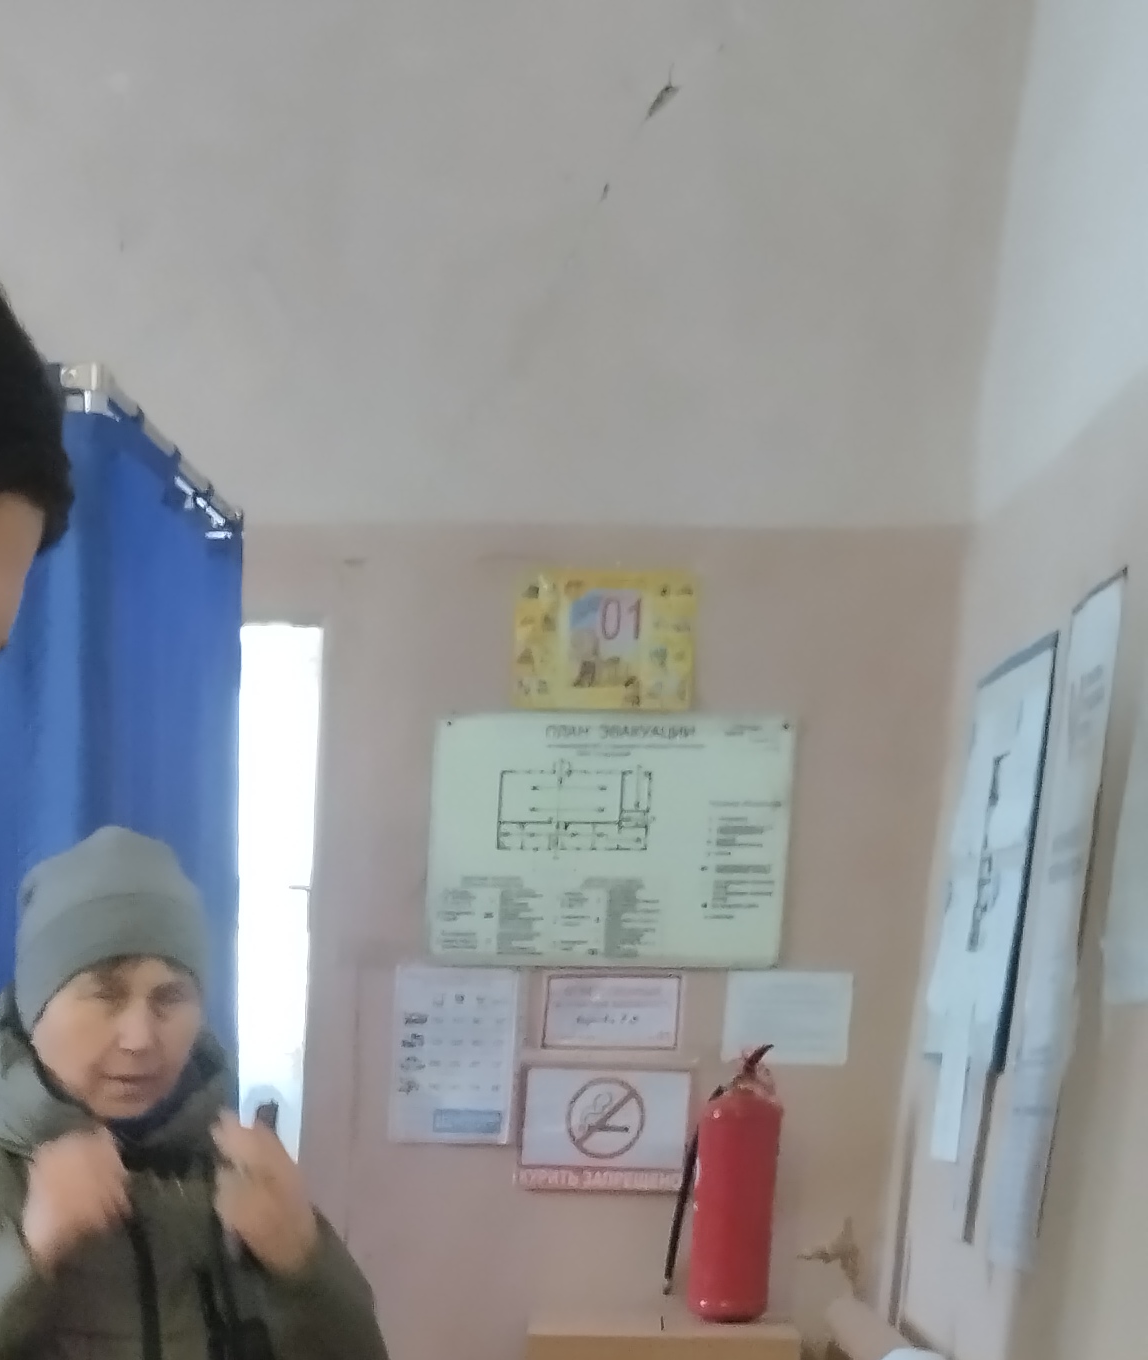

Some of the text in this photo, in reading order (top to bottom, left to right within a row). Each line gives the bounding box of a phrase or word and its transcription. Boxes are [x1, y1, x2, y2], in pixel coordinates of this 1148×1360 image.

[601, 598, 642, 640] 01
[545, 723, 592, 739] ПЛАН
[519, 1168, 579, 1188] КУРИТЬ
